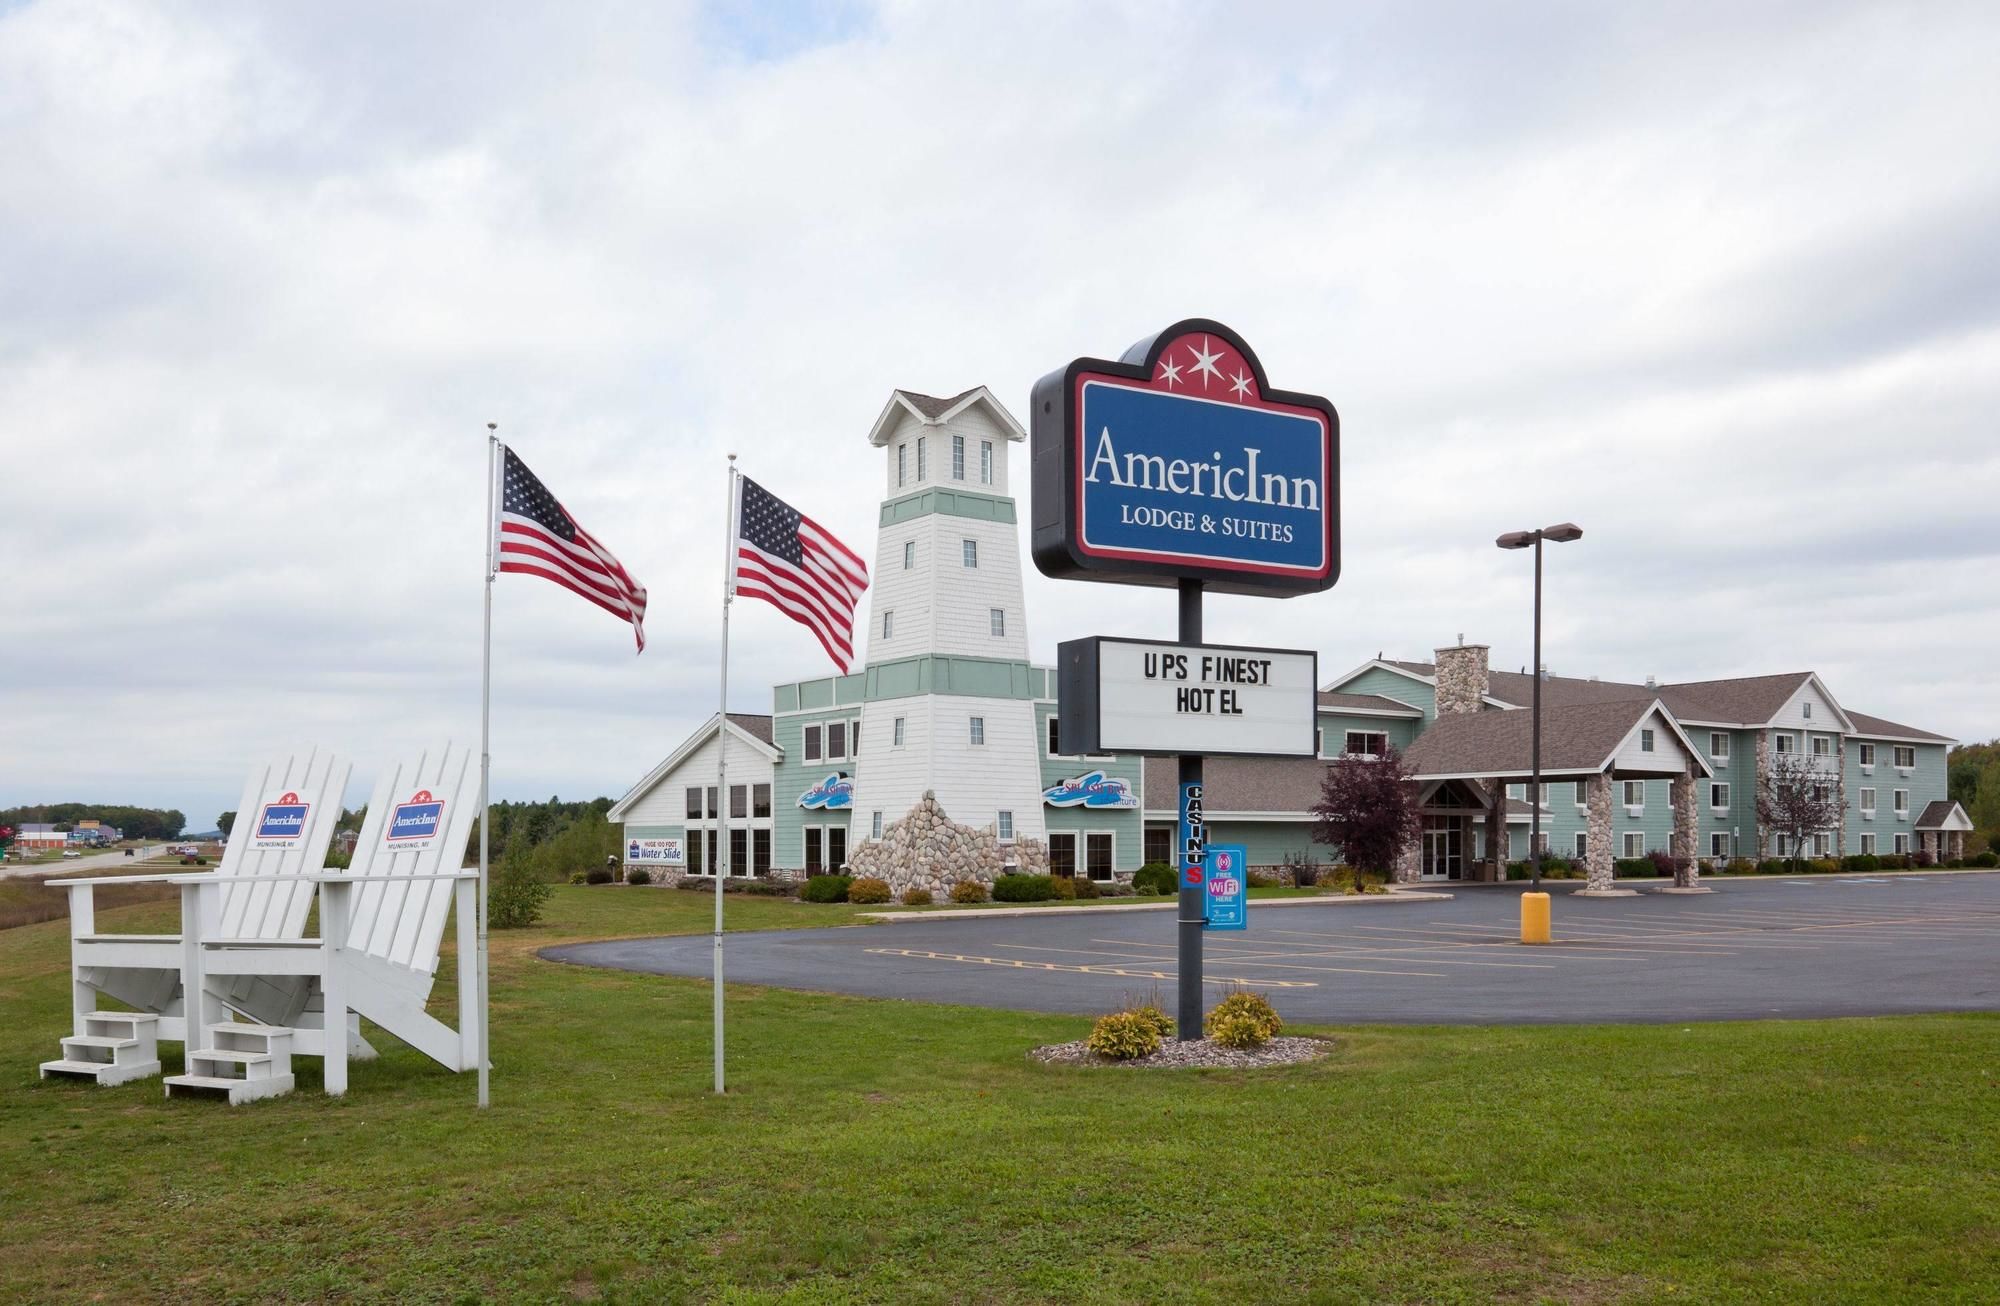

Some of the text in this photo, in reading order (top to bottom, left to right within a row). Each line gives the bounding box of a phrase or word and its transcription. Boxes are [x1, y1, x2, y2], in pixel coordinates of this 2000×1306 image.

[1085, 426, 1320, 511] AmericInn
[1121, 504, 1293, 544] LODGE & SUITES
[1144, 653, 1271, 684] UPS FINEST
[1177, 687, 1243, 714] HOTEL
[263, 814, 303, 826] AmericInn
[393, 813, 437, 827] AmericInn
[1186, 785, 1204, 884] CASINOS
[641, 848, 661, 859] Water
[663, 848, 681, 859] Slide
